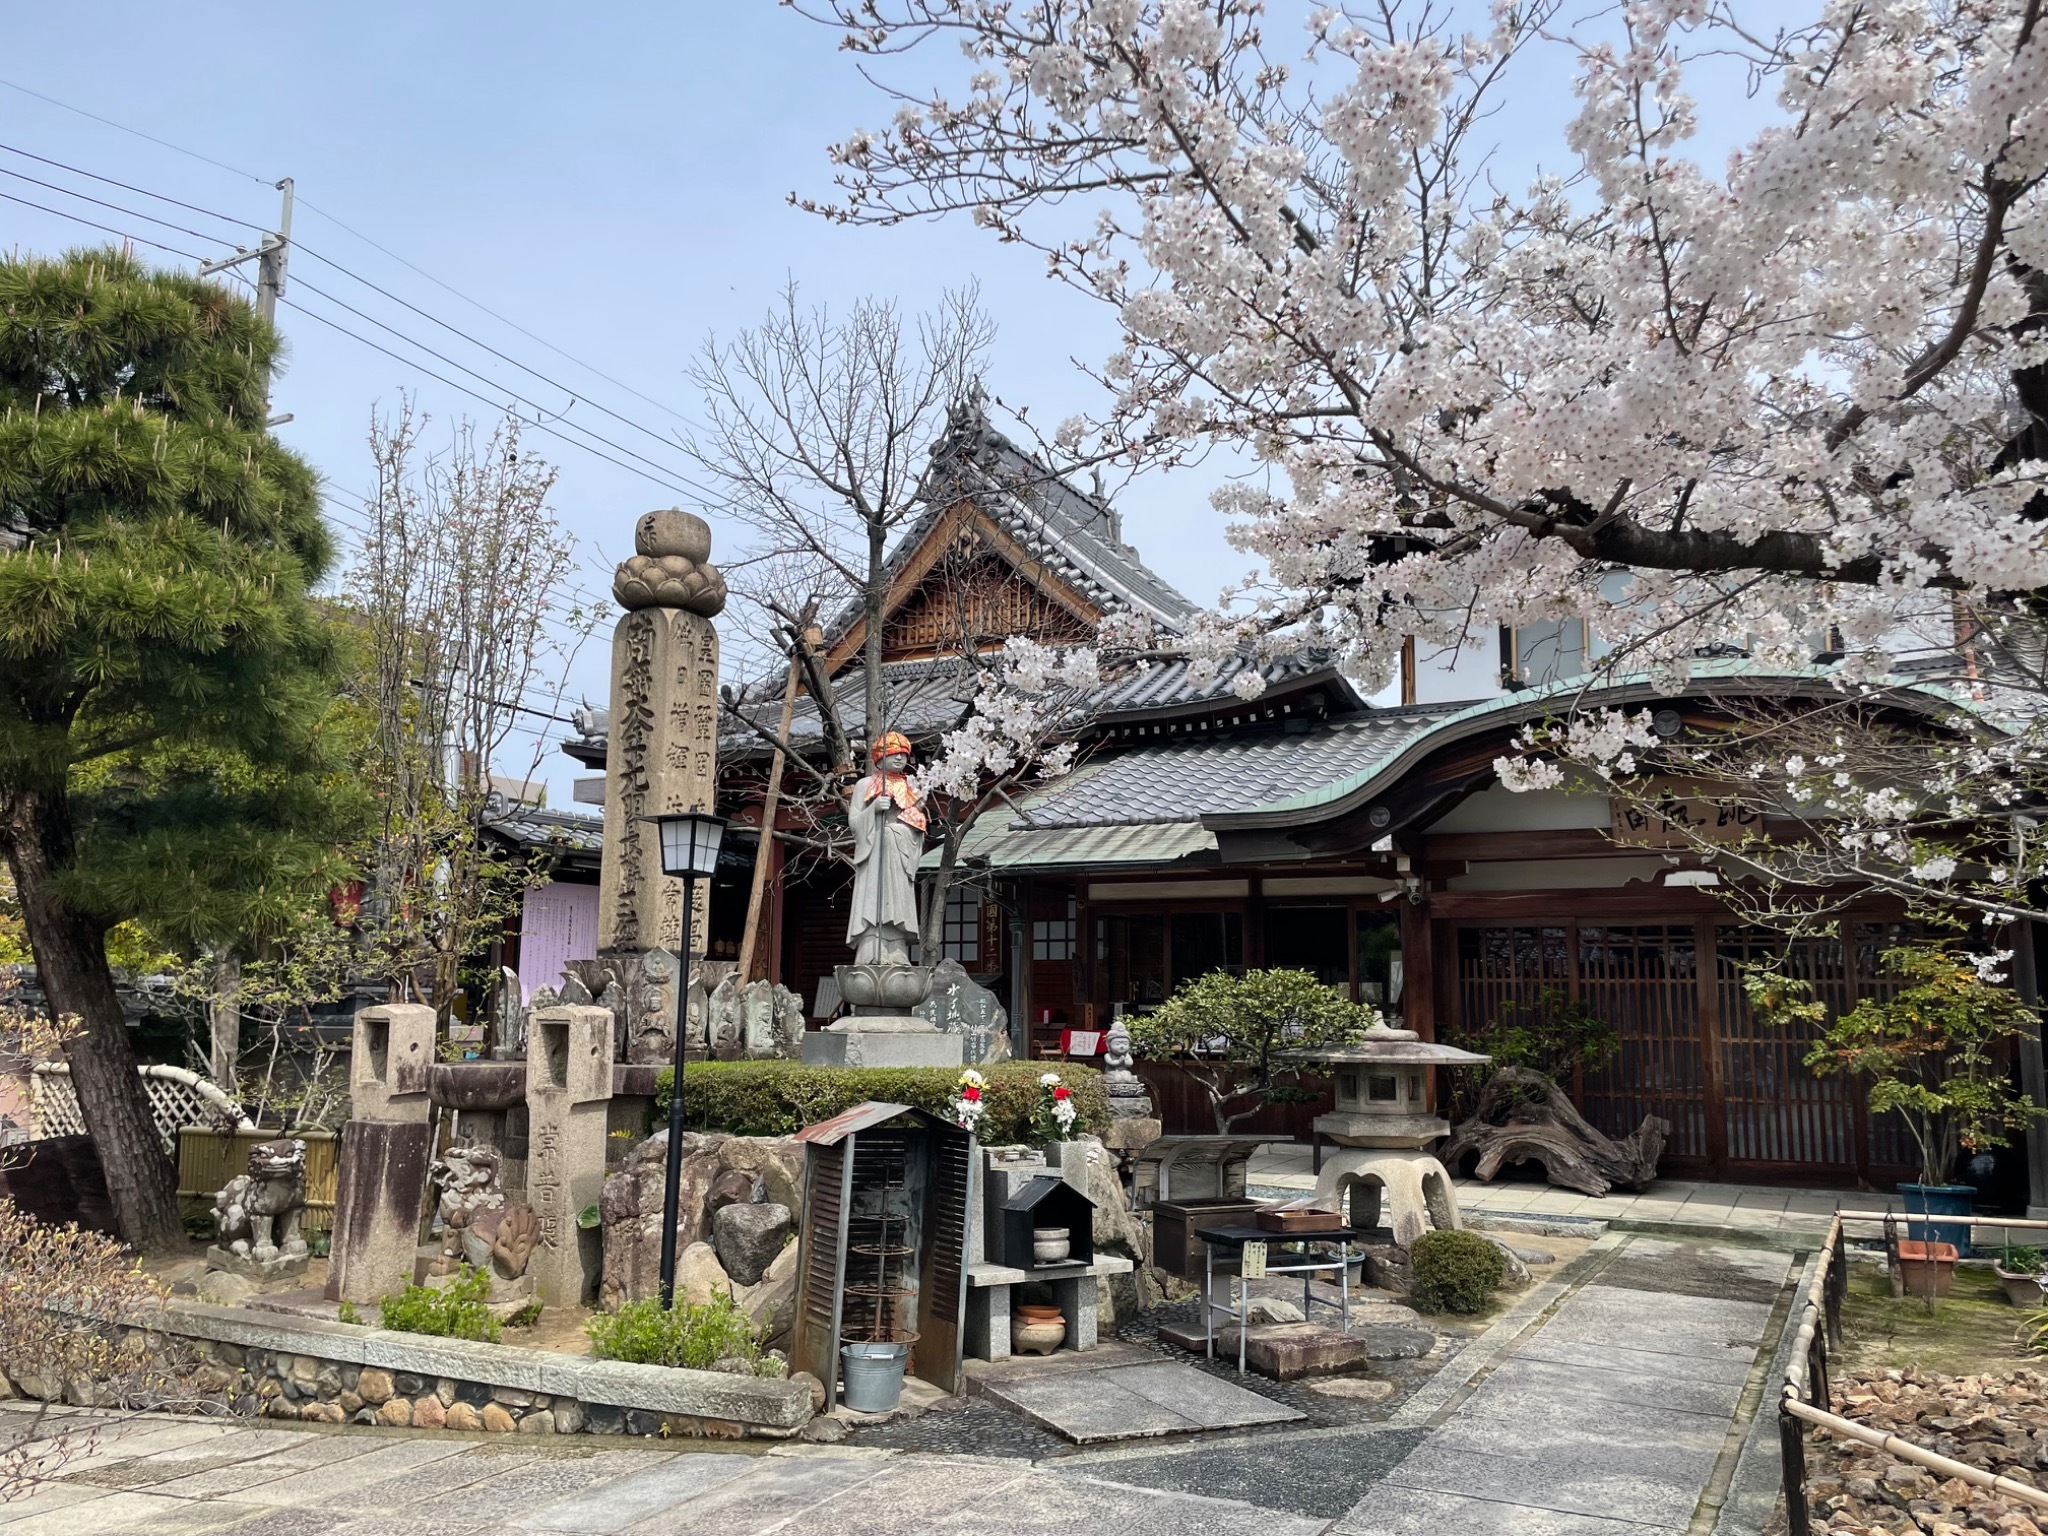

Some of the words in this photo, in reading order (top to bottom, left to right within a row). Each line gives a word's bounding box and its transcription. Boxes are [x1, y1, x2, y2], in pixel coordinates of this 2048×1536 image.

[985, 897, 999, 975] 國第十二番
